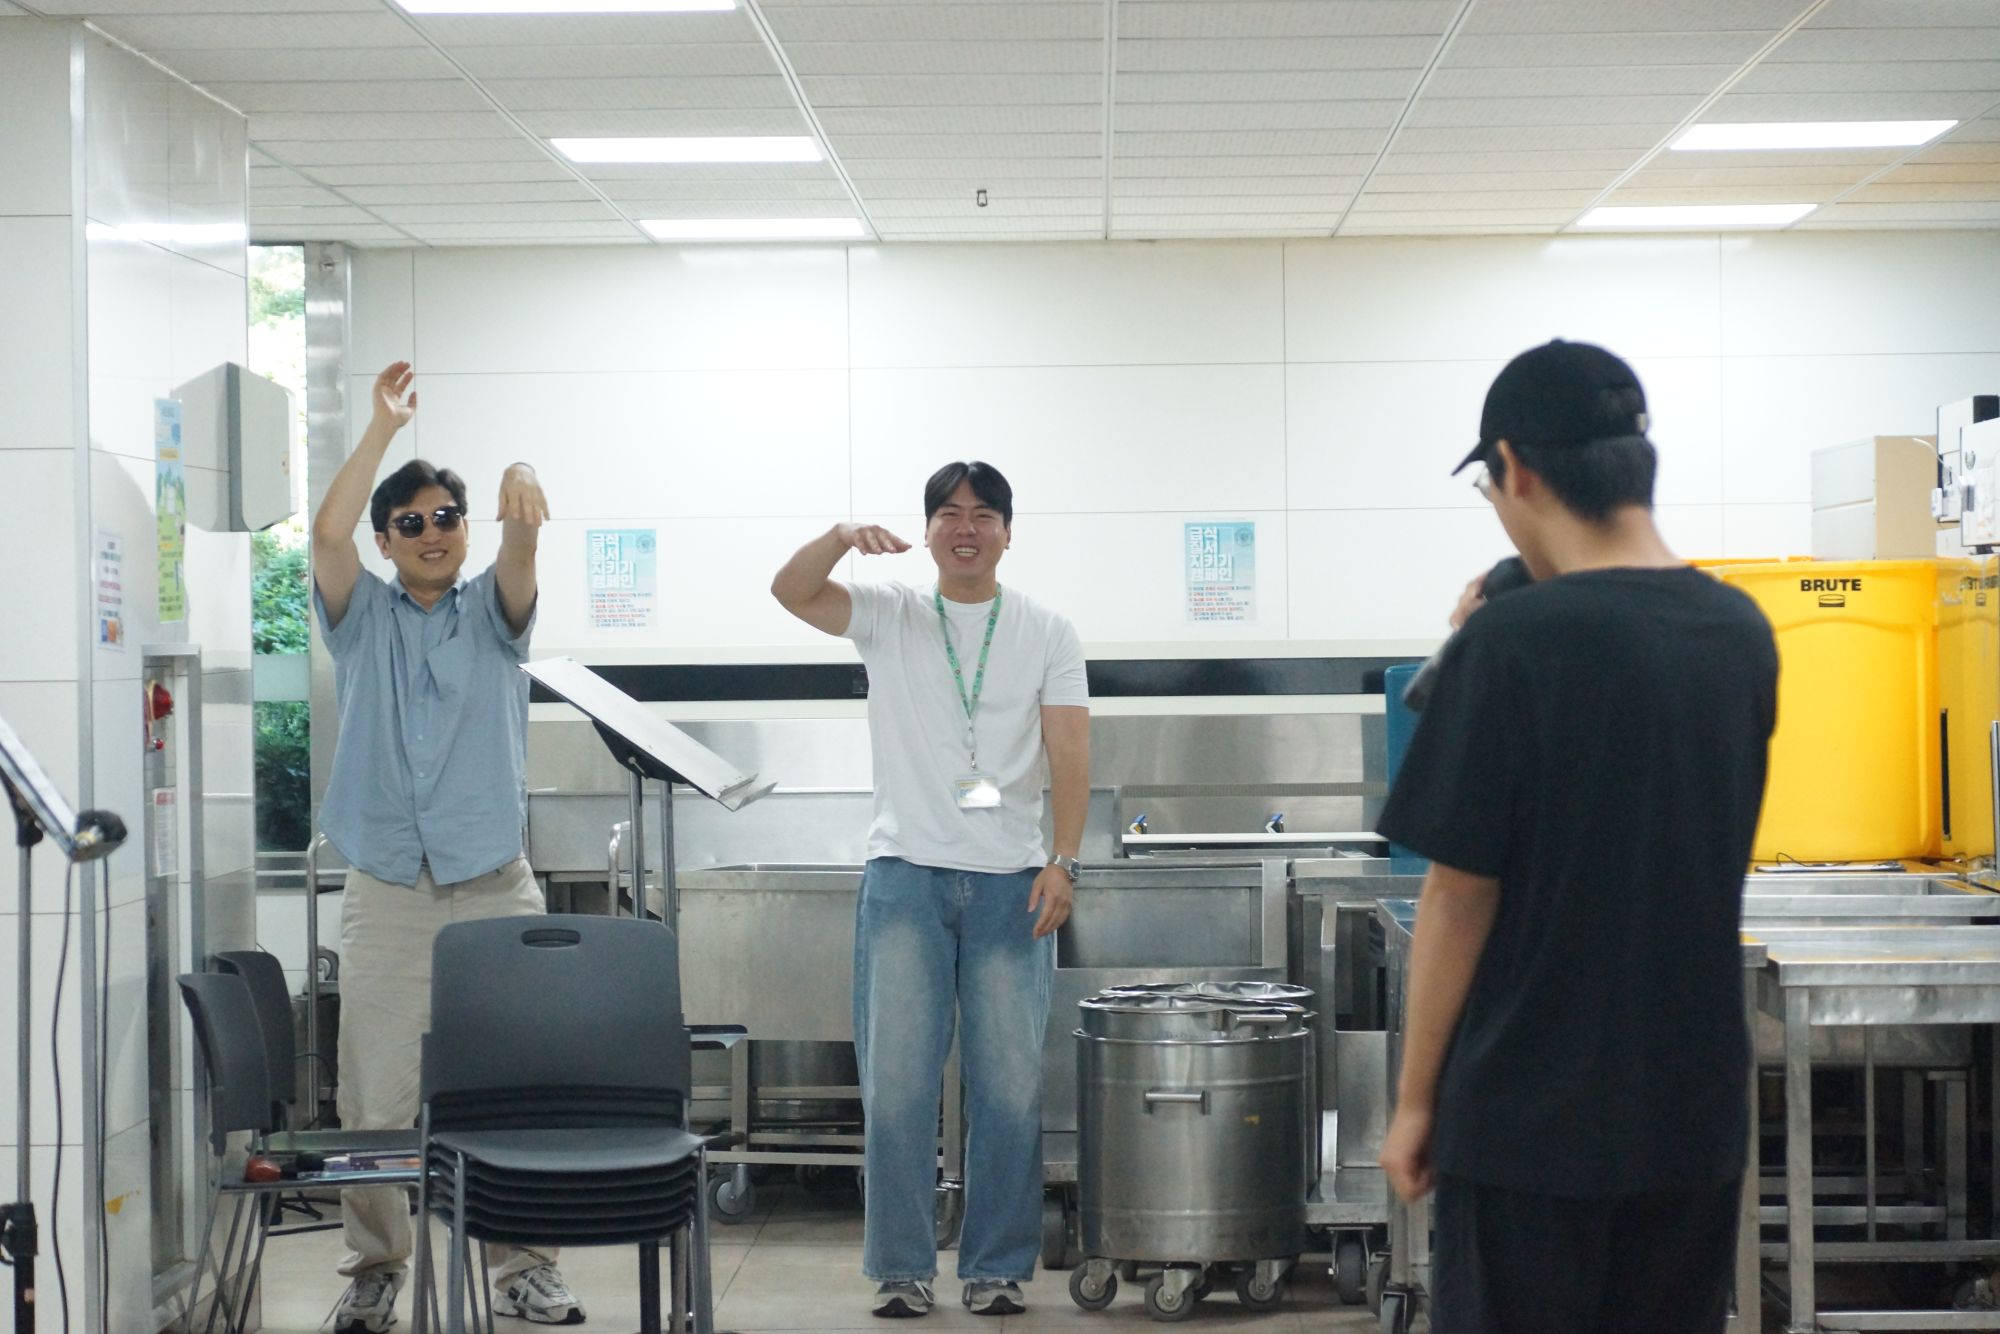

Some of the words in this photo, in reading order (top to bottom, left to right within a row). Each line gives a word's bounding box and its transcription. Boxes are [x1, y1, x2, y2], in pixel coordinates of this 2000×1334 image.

[592, 561, 633, 575] 지키기
[1190, 554, 1232, 568] 지키기
[1801, 579, 1861, 592] BRUTE
